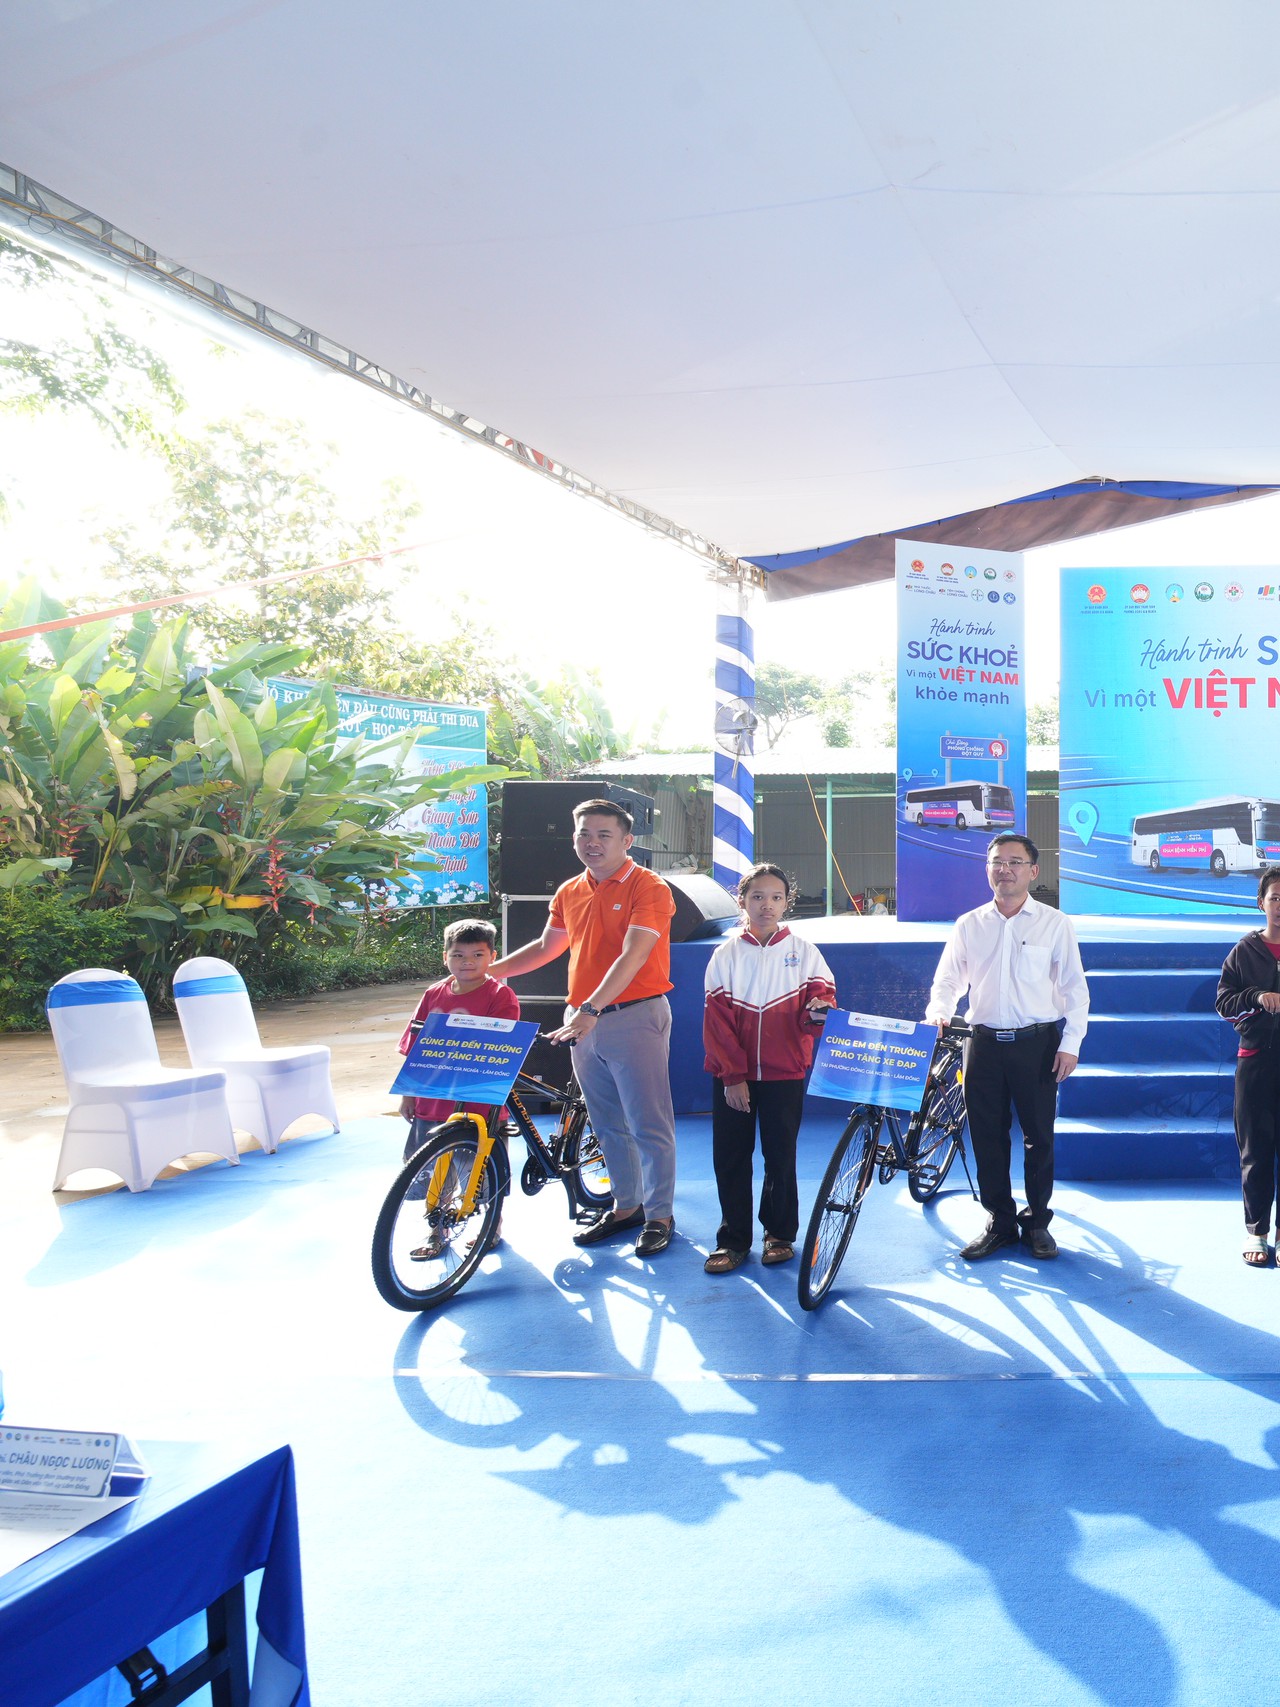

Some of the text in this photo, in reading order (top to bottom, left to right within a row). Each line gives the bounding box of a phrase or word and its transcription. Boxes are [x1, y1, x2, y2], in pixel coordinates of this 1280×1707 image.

[930, 618, 995, 636] Hành trình
[907, 638, 1018, 668] SỨC KHOẺ
[1140, 637, 1196, 669] Hành
[1198, 633, 1248, 662] trình
[907, 666, 1018, 685] Vì một VIỆT NAM
[916, 686, 1009, 706] khỏe mạnh
[1084, 689, 1108, 707] Vì
[1114, 689, 1156, 711] một
[1162, 669, 1256, 717] VIỆT
[381, 704, 410, 721] CŨNG
[413, 707, 438, 723] PHẢI
[441, 713, 457, 725] THI
[460, 714, 479, 728] ĐUA
[419, 1037, 445, 1045] CÙNG
[461, 1039, 482, 1050] ĐẾN
[483, 1043, 523, 1054] TRƯỜNG
[826, 1036, 927, 1058] CÙNG EM ĐẾN TRƯỜNG
[421, 1050, 510, 1066] TRAO TẶNG XE ĐẠP
[830, 1050, 917, 1069] TRAO TẶNG XE ĐẠP
[9, 1451, 38, 1465] CHÂU
[40, 1455, 69, 1470] NGỌC
[72, 1457, 110, 1470] LƯƠNG
